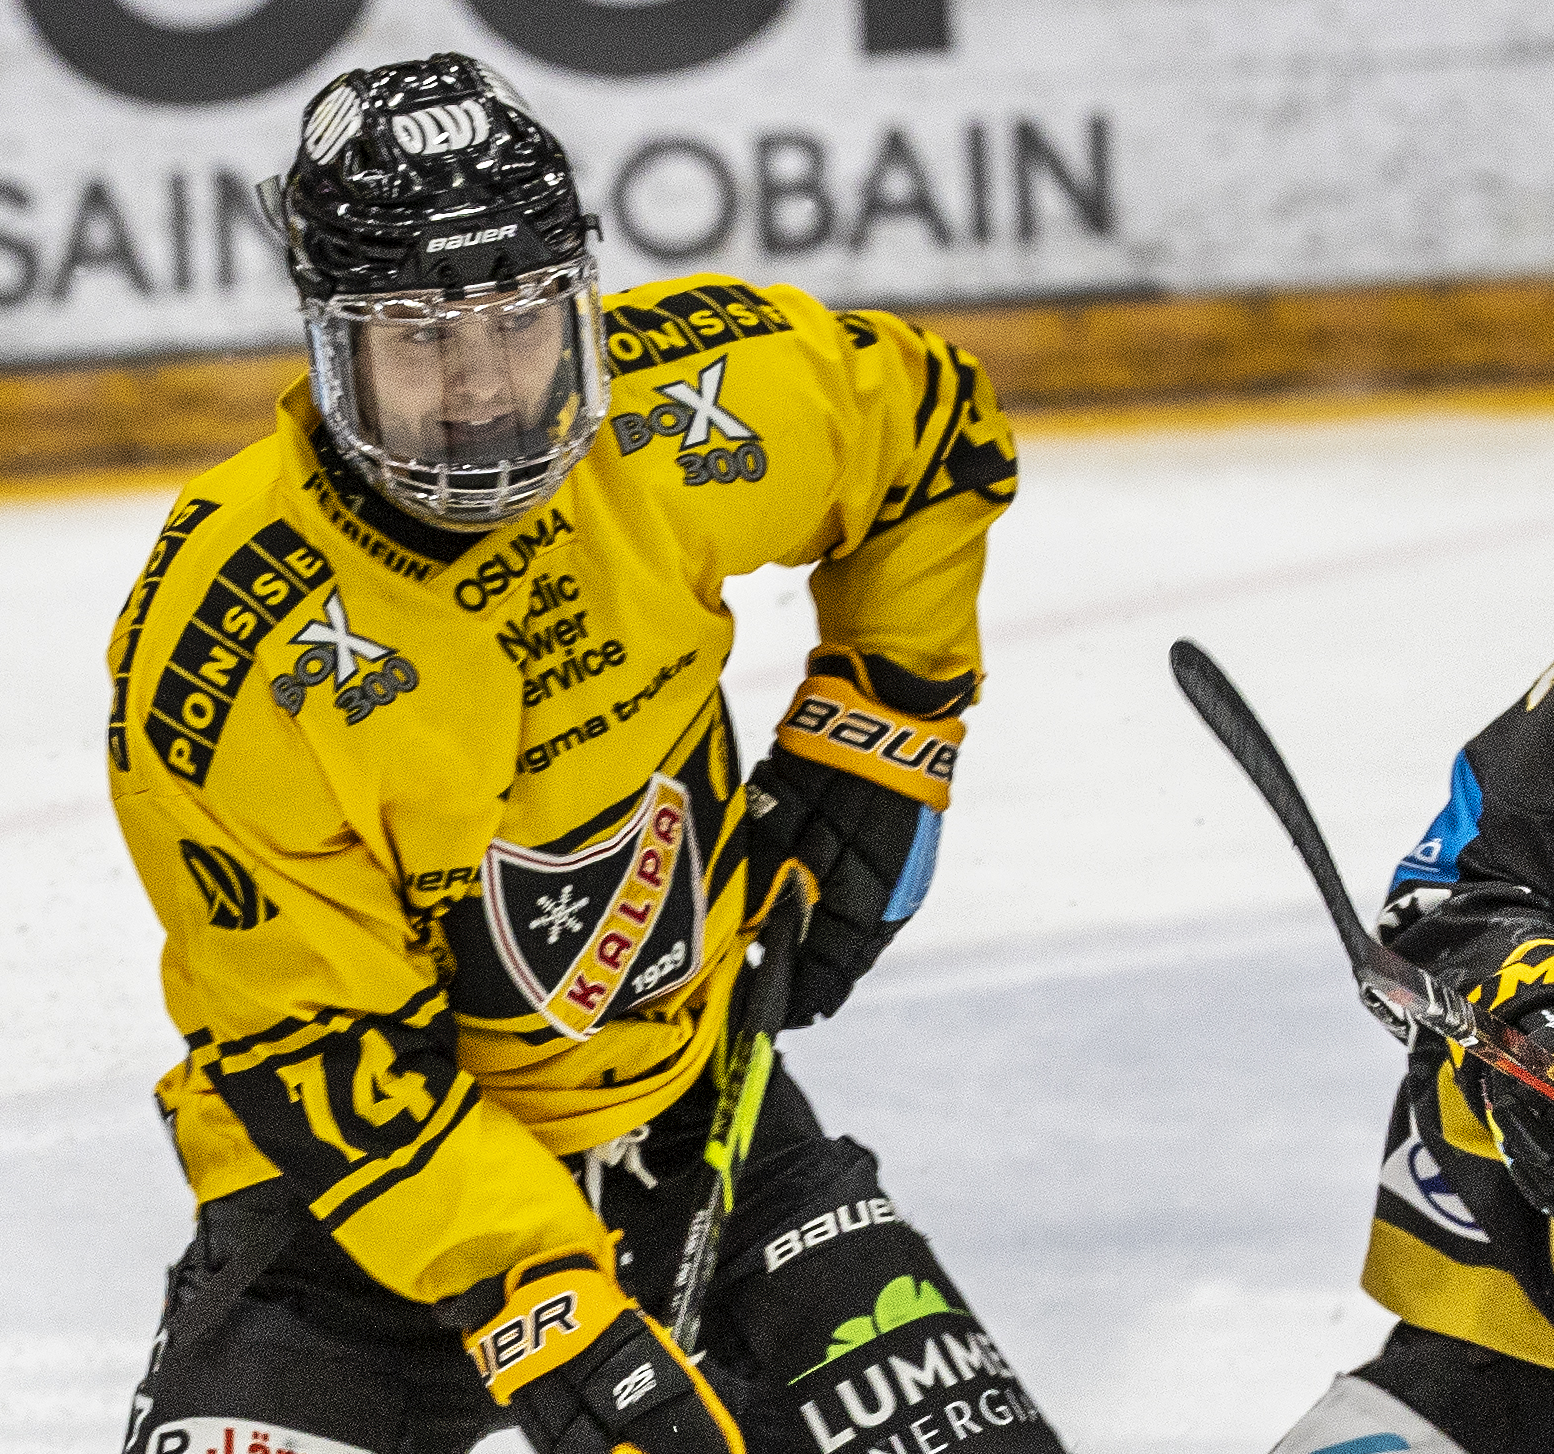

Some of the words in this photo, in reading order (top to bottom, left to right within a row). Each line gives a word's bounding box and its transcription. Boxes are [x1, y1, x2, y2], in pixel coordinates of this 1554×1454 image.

[613, 112, 1115, 264] OBAIN
[426, 223, 519, 254] BAUER
[610, 353, 764, 458] BOX
[675, 441, 769, 487] 300
[454, 508, 574, 612] OSUMA
[168, 547, 325, 776] PONSSE
[333, 657, 421, 728] 300
[523, 638, 628, 709] ervice
[517, 714, 610, 775] igma
[567, 807, 683, 1013] KALPA
